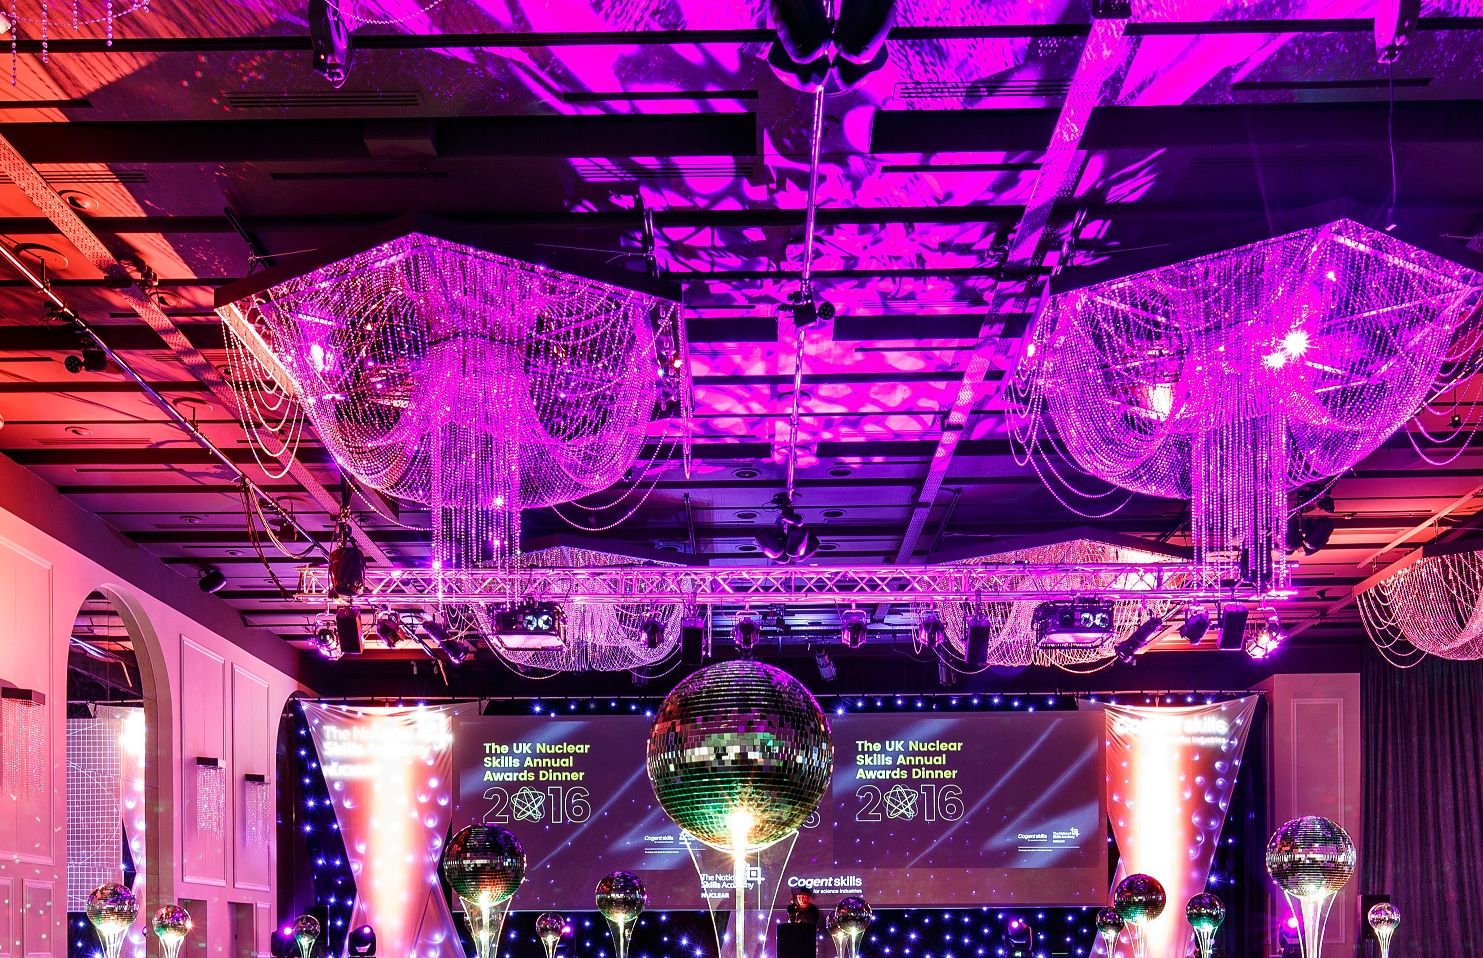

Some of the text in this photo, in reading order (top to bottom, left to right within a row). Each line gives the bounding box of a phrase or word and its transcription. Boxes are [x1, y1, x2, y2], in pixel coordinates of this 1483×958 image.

[483, 742, 591, 754] The UK Nuclear
[856, 740, 963, 752] The UK Nuclear
[483, 756, 574, 768] Skills Annual
[856, 754, 947, 766] Skills Annual
[483, 769, 585, 782] Awards Dinner
[856, 767, 958, 779] Awards Dinner
[701, 881, 721, 889] Skills
[787, 875, 863, 889] Cogent skills
